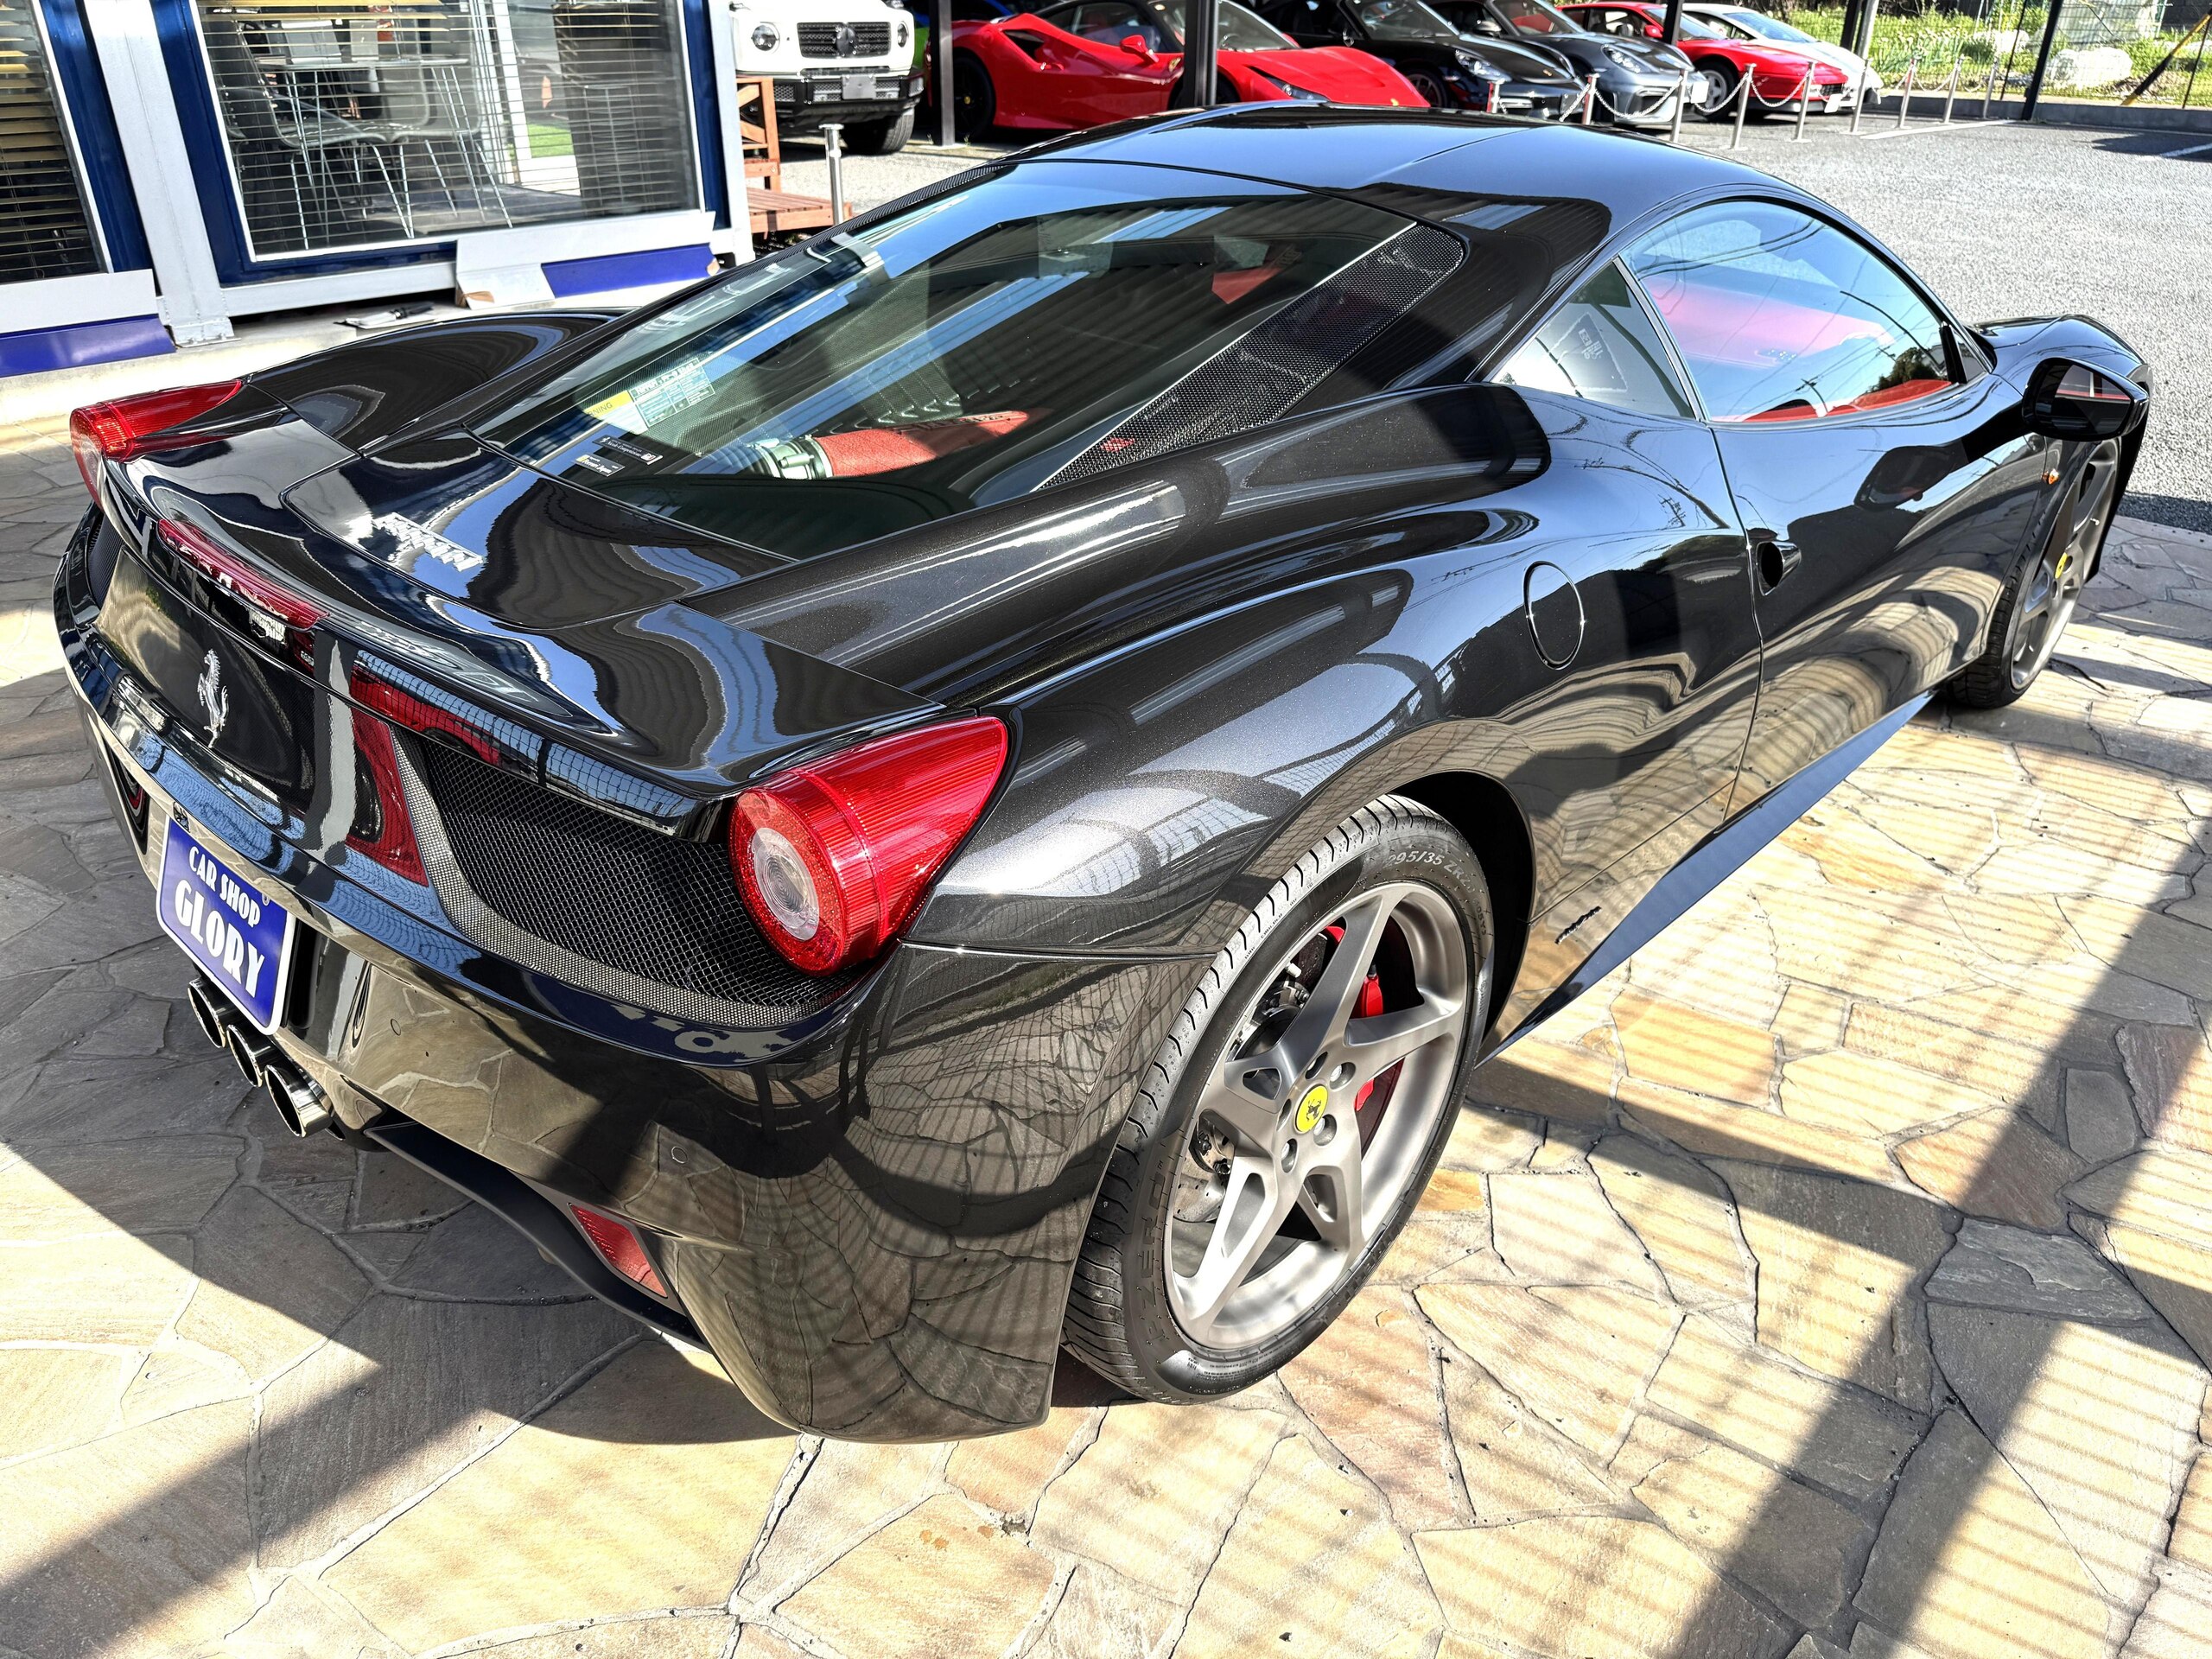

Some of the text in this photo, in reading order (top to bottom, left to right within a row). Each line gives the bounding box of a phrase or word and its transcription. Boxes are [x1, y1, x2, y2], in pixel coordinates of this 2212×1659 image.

[189, 846, 261, 928] CAR SHOP
[1382, 850, 1446, 869] 295/35
[175, 880, 265, 998] GLORY
